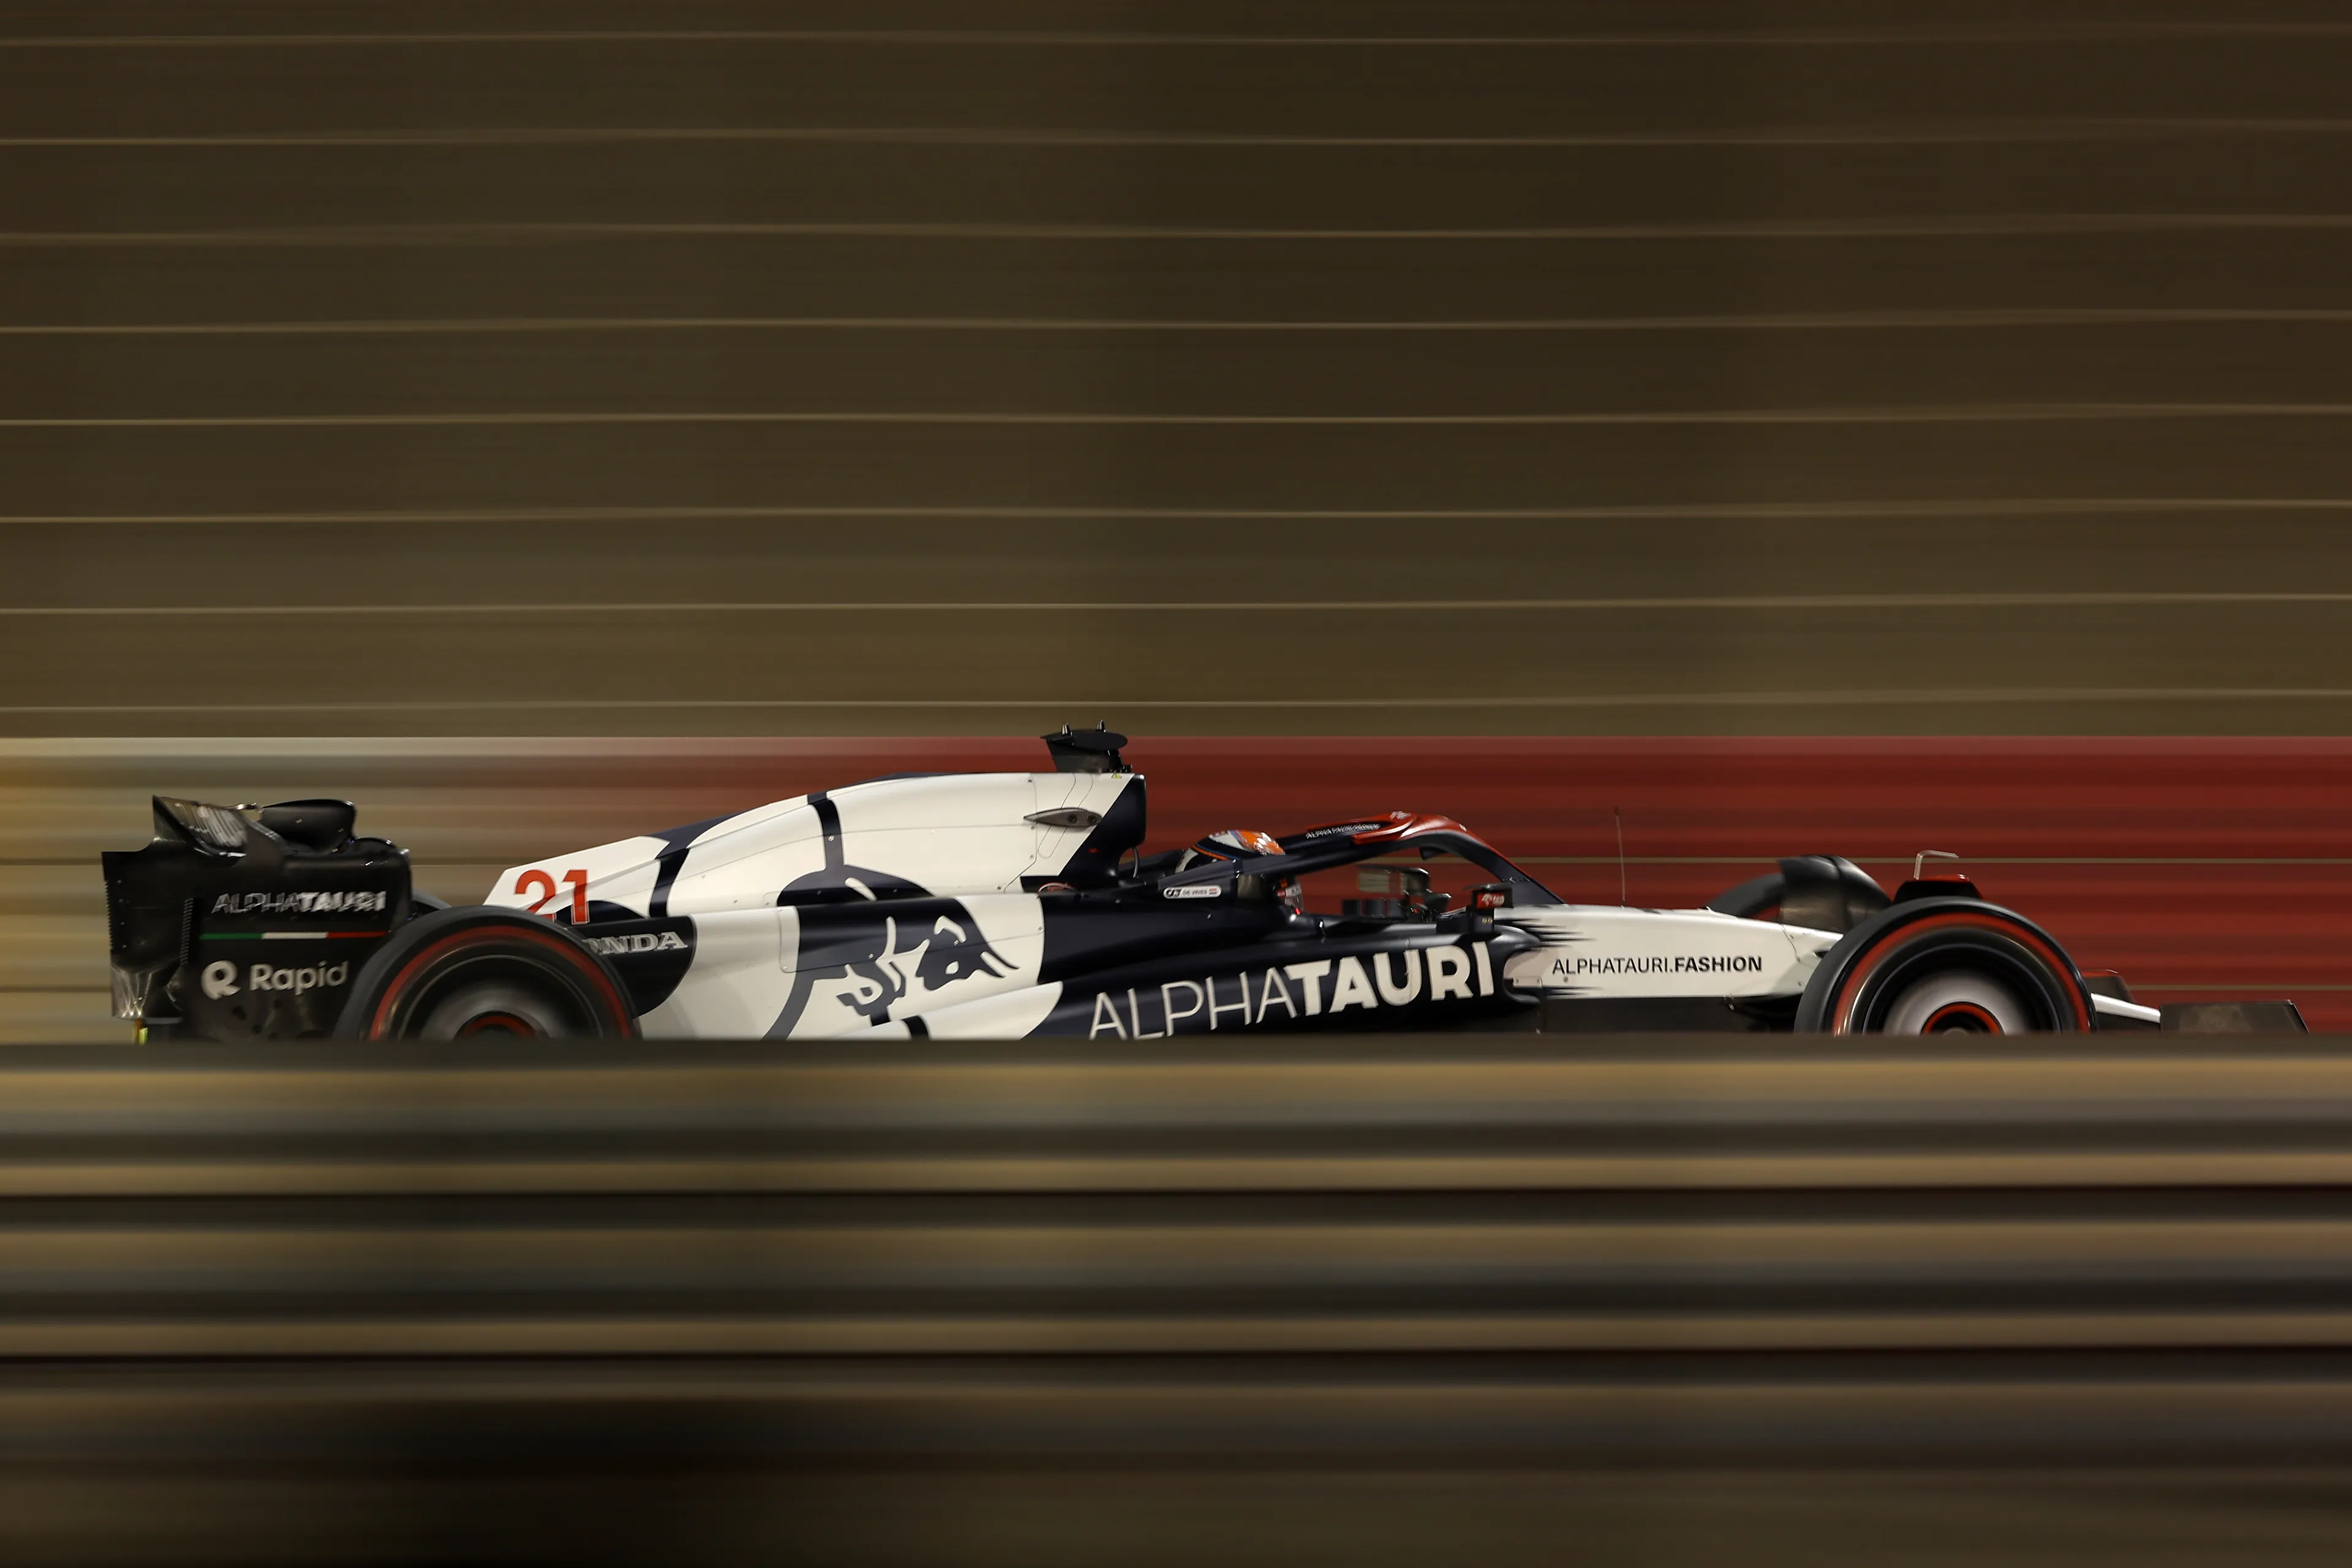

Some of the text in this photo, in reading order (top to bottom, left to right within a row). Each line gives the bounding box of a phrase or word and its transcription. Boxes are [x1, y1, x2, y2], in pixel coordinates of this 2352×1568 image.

[211, 891, 386, 914] ALPHATAURI
[513, 869, 590, 925] 21
[249, 960, 349, 996] Rapid
[1552, 956, 1763, 974] ALPHATAURI.FASHION
[1089, 941, 1494, 1041] ALPHATAURI
